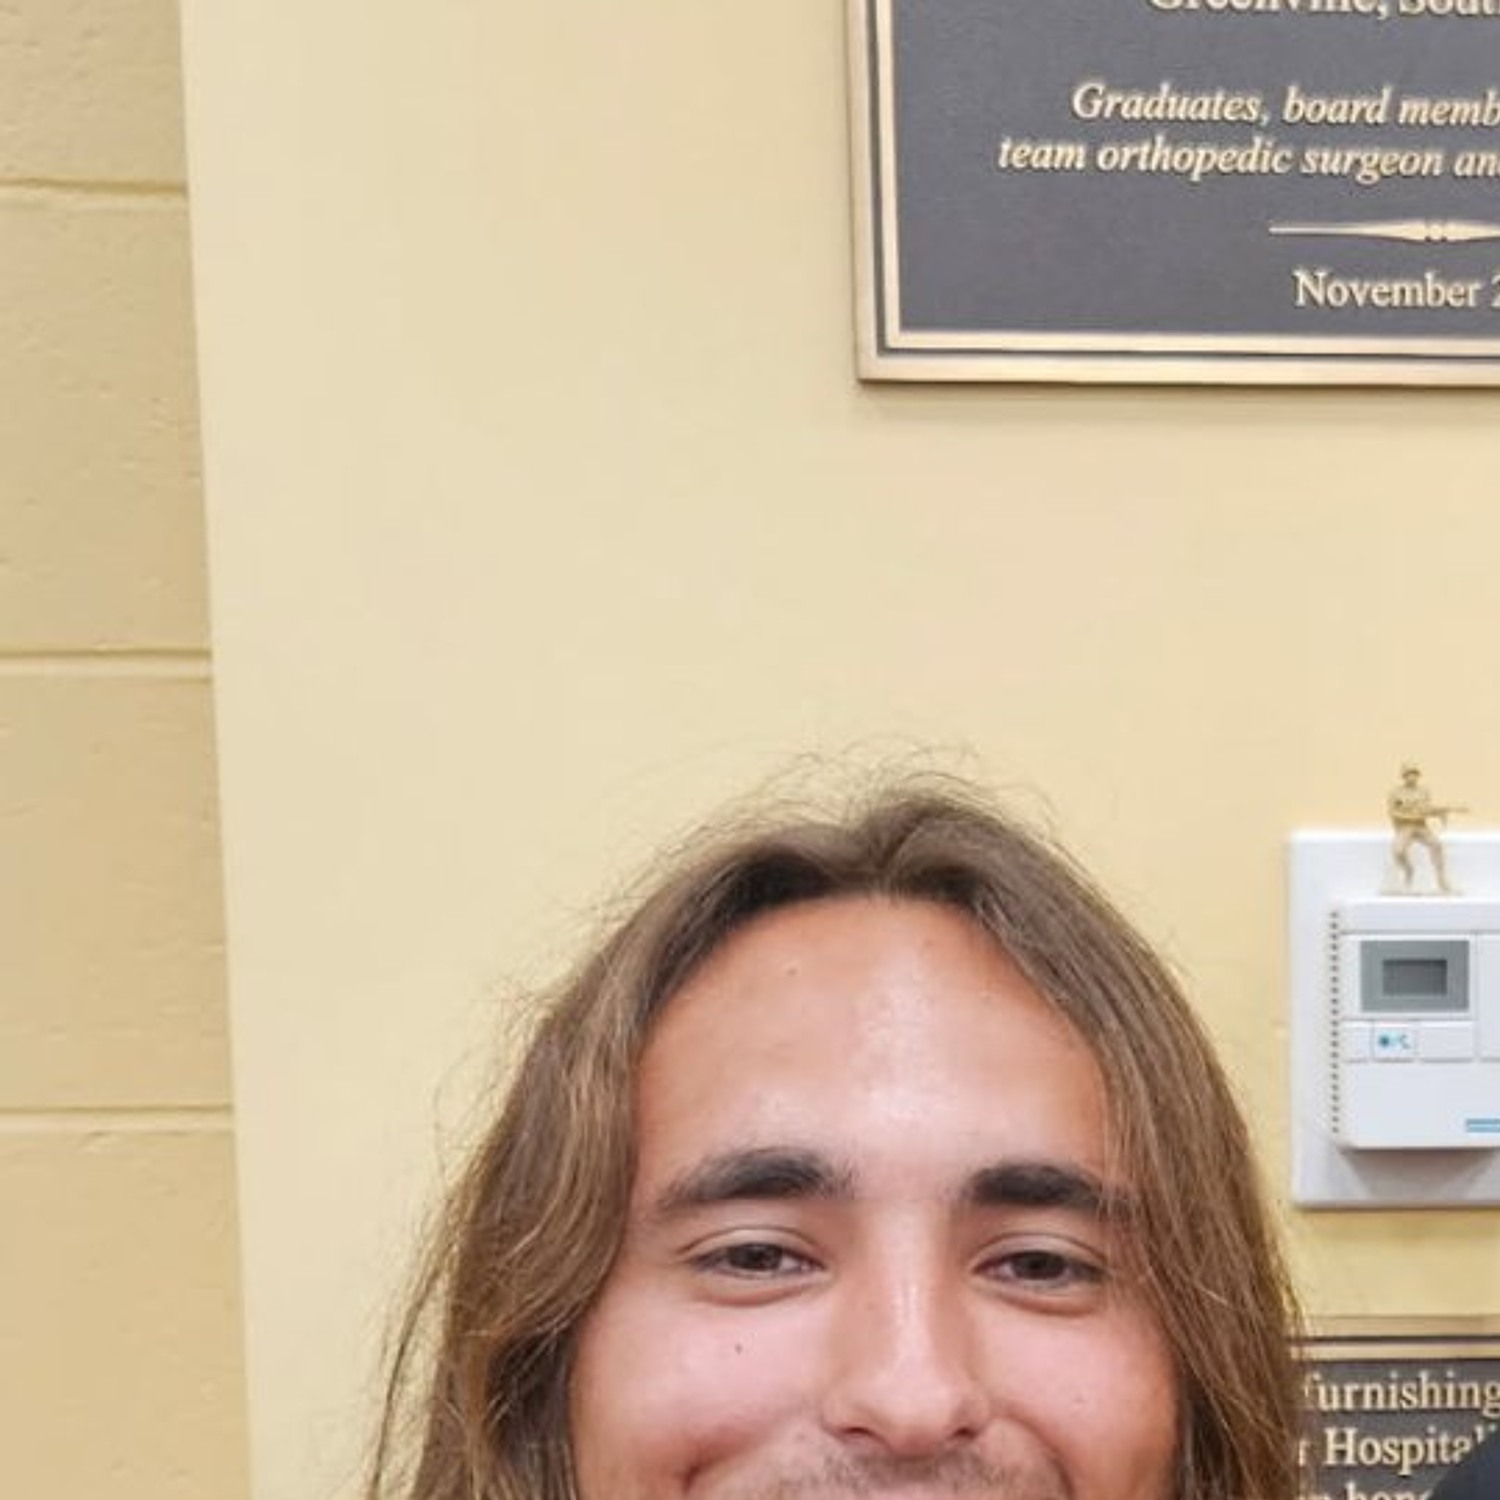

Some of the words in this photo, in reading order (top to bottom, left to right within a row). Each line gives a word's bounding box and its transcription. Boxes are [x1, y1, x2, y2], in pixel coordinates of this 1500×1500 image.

[1072, 82, 1271, 126] Graduates,
[1282, 85, 1393, 124] board
[999, 135, 1087, 171] team
[1097, 135, 1293, 182] orthopedic
[1301, 146, 1444, 184] surgeon
[1293, 268, 1482, 308] November
